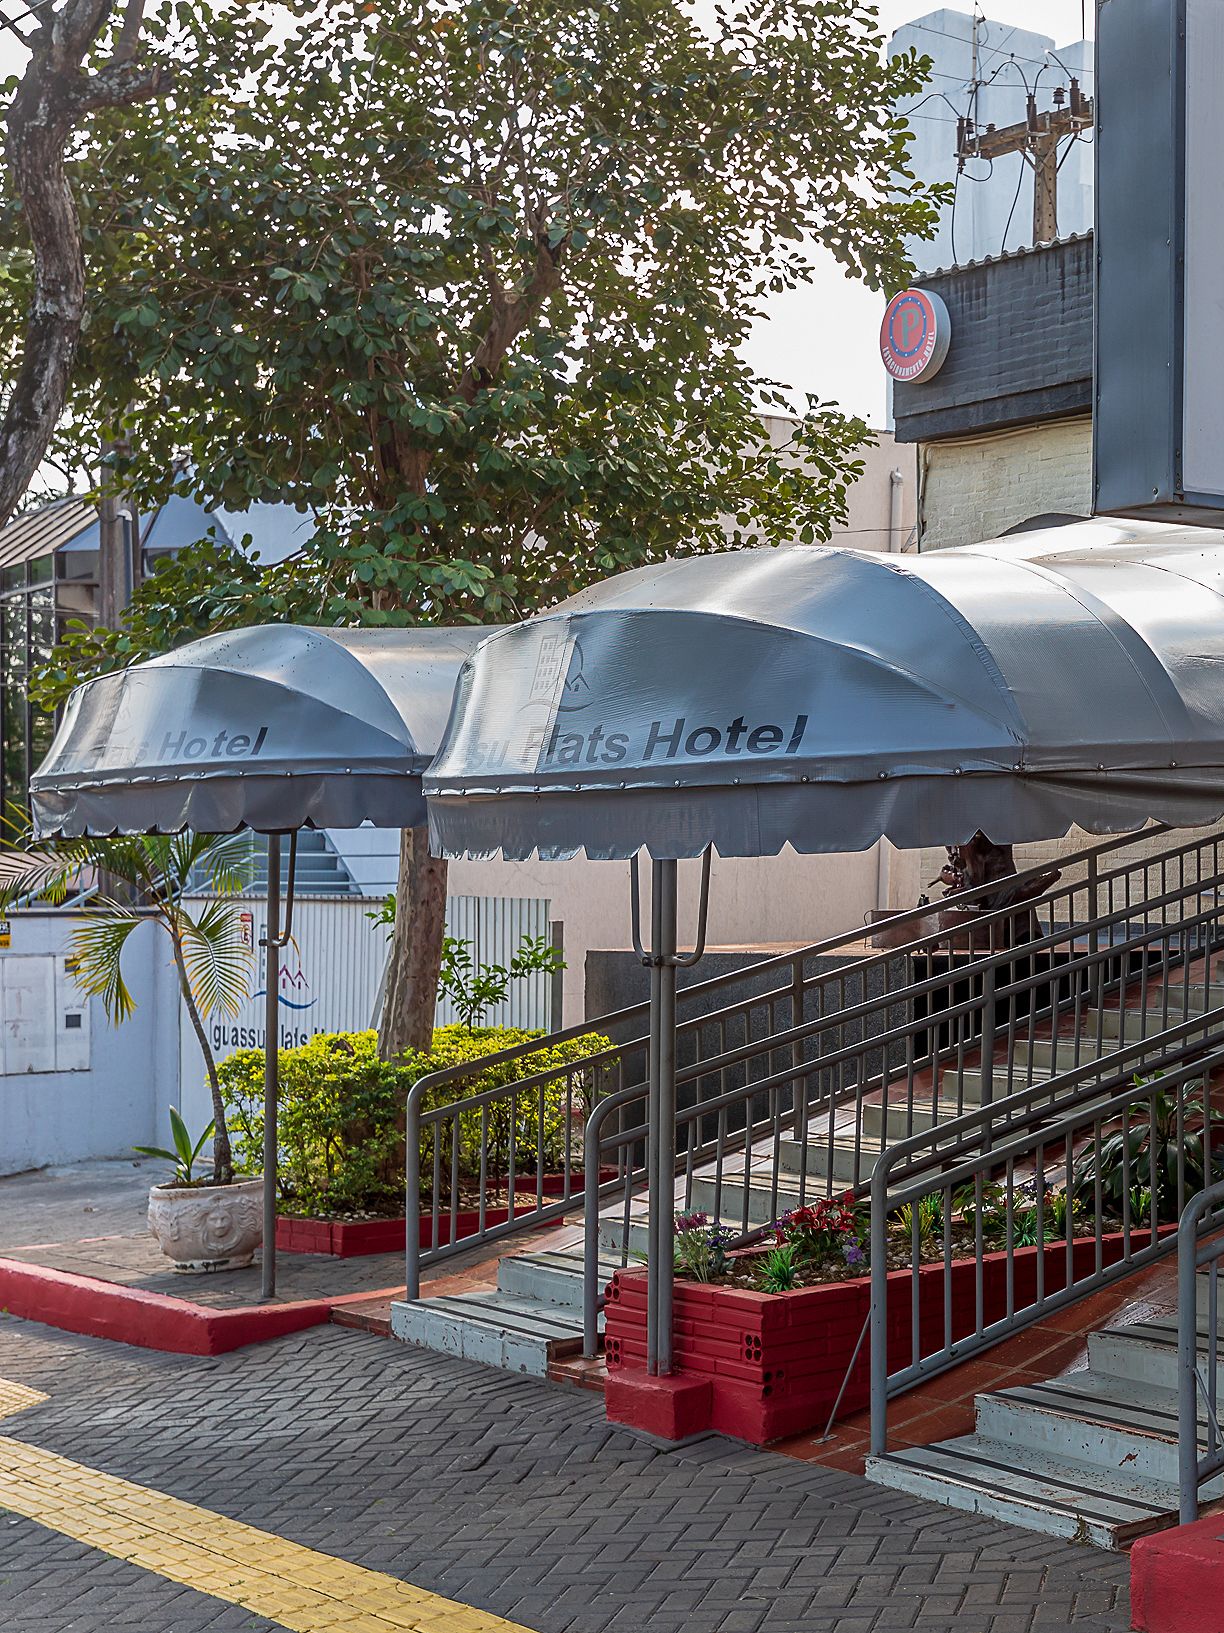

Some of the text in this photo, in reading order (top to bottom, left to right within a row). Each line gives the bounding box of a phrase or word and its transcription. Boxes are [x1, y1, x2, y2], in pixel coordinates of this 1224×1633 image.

[897, 308, 920, 348] P
[158, 727, 269, 761] Hotel
[643, 714, 808, 761] Hotel
[281, 1024, 309, 1050] lats
